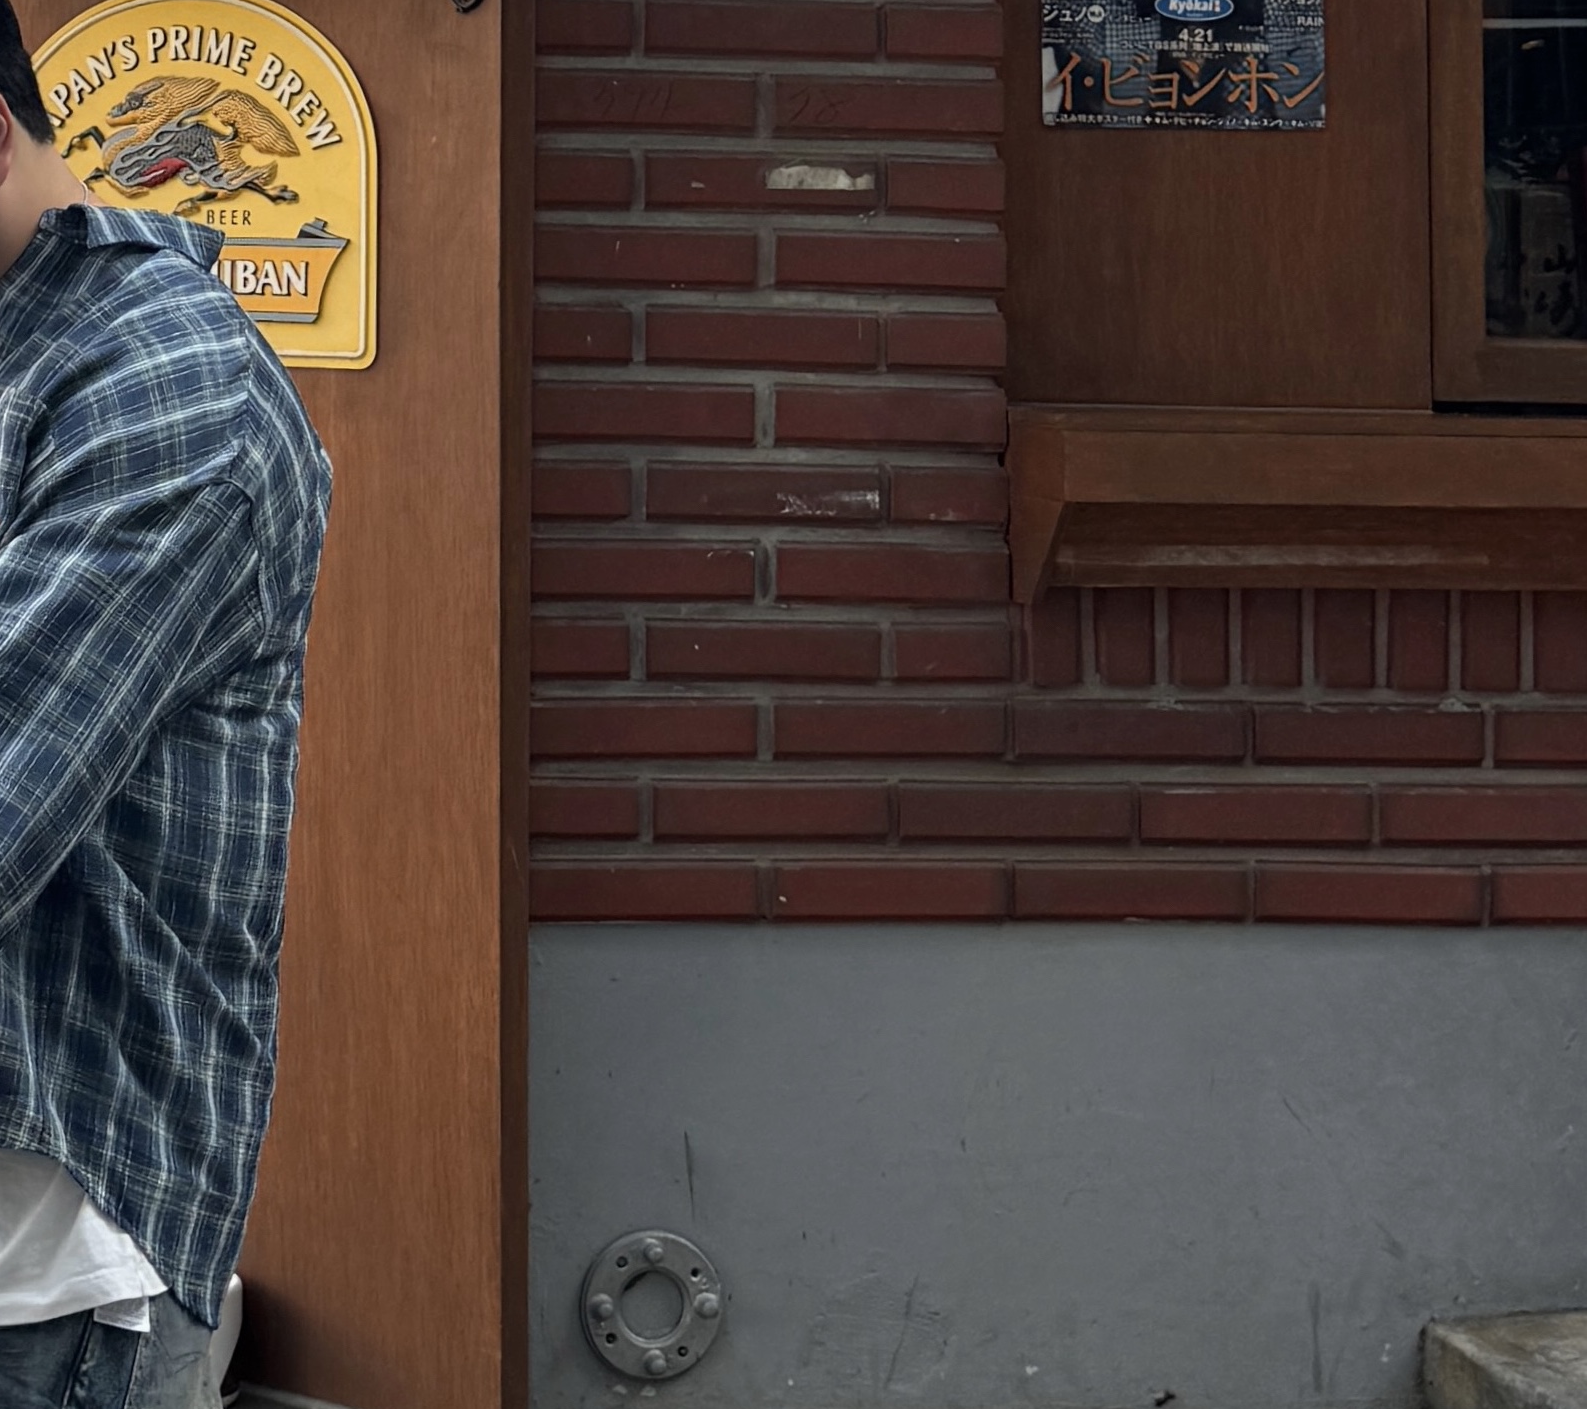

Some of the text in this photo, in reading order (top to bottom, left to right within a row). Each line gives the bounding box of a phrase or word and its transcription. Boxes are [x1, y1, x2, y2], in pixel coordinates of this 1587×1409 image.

[146, 24, 256, 76] PRIME
[254, 53, 343, 152] BREW
[1046, 51, 1325, 114] イ・ビョンホン
[207, 209, 252, 226] BEER
